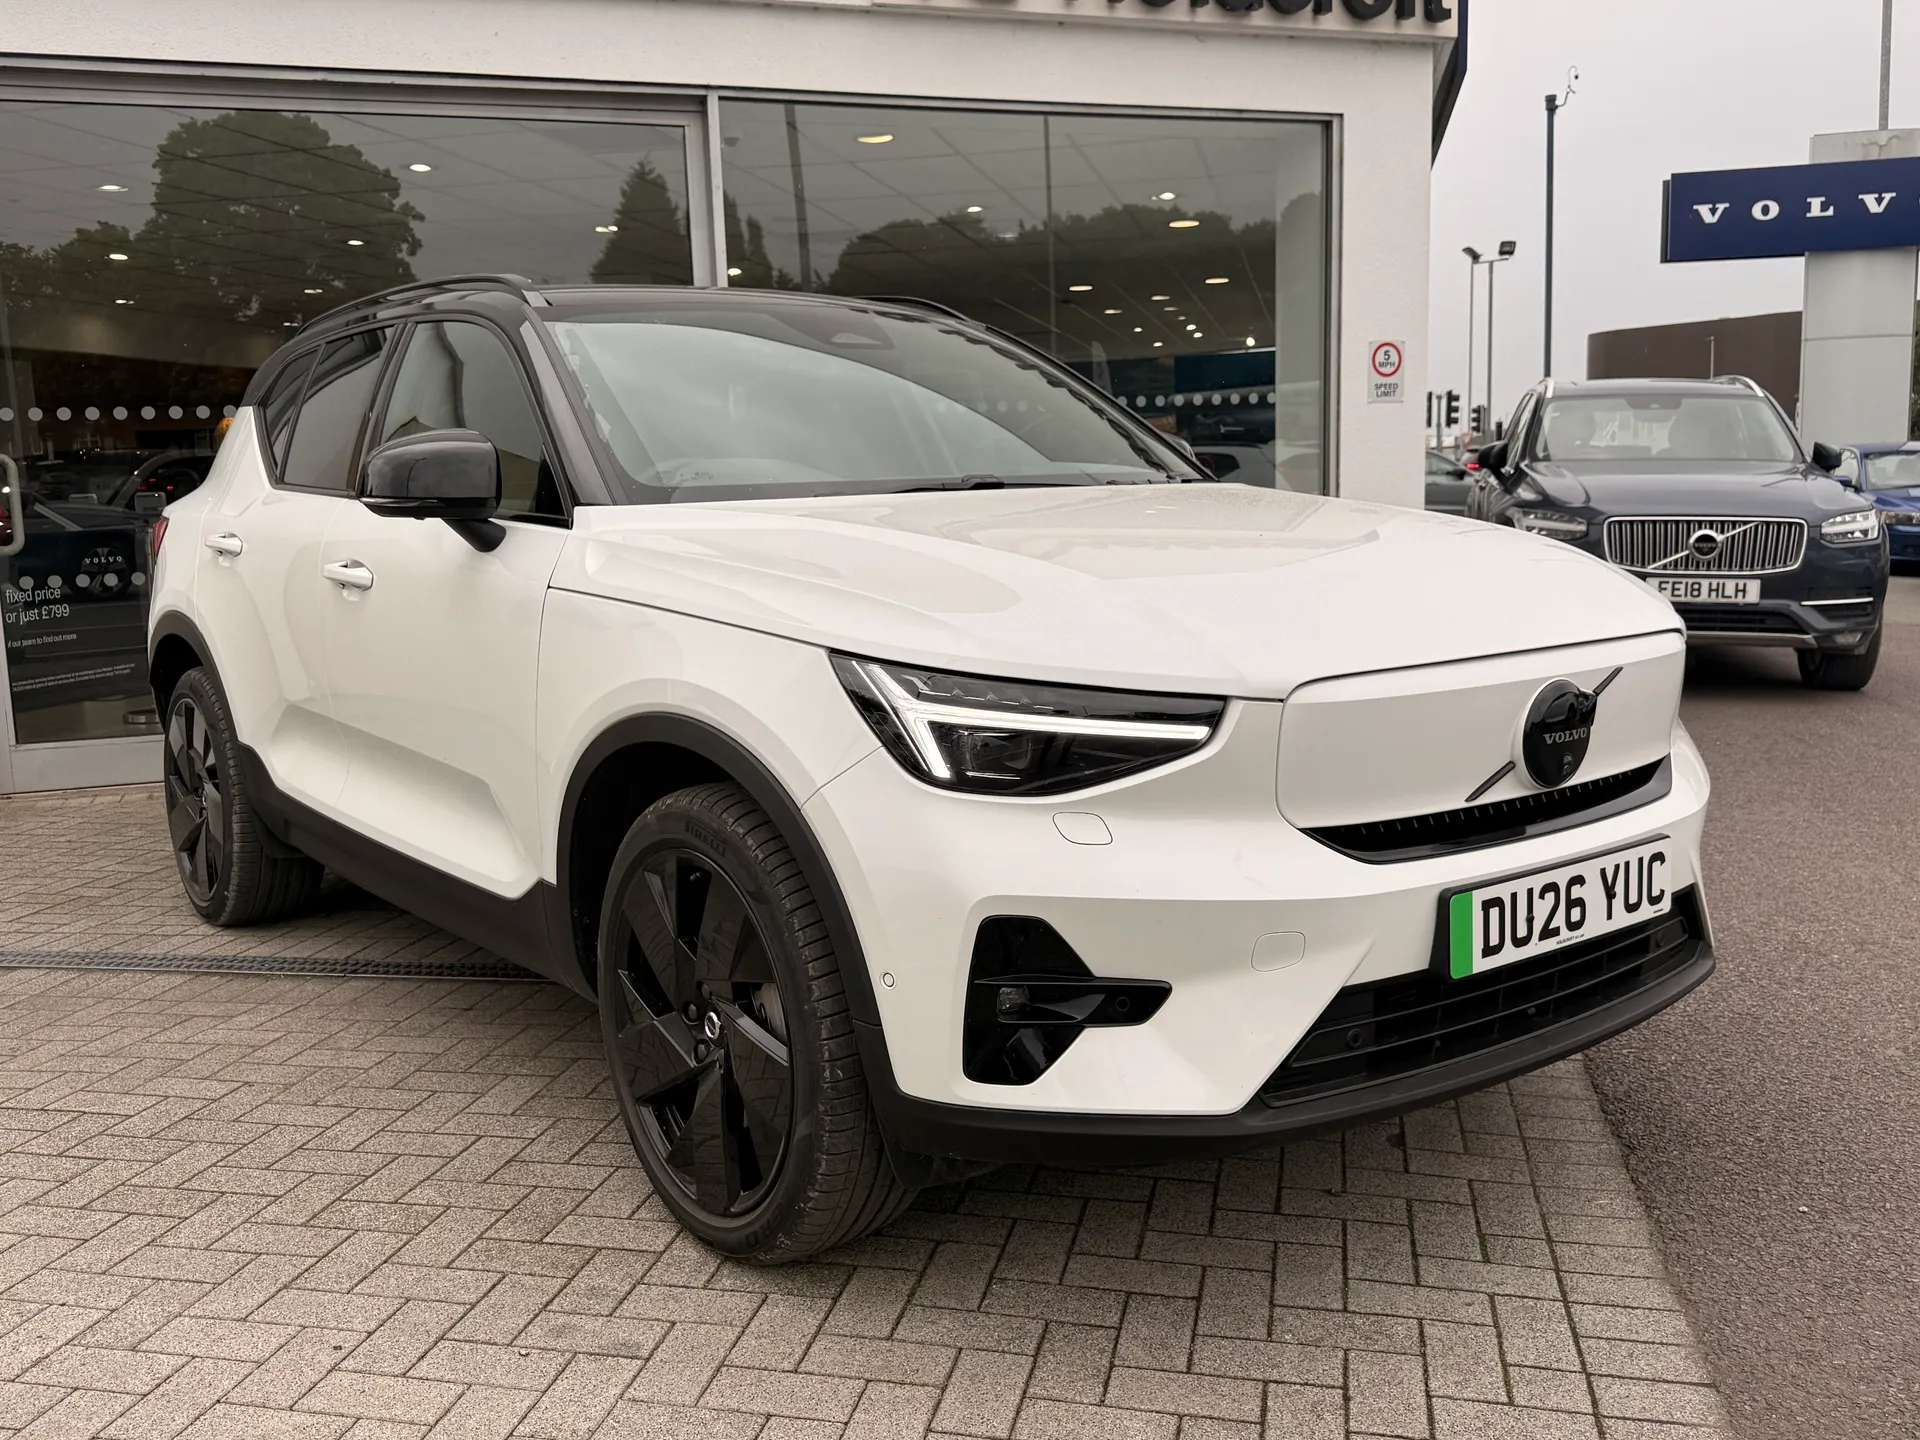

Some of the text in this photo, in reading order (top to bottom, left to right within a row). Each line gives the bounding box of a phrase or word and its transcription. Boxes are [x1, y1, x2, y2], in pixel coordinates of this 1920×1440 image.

[1693, 192, 1920, 224] VOLV
[1383, 350, 1391, 361] 5
[1374, 383, 1399, 391] SPEED
[84, 555, 123, 564] VOLVO
[6, 586, 61, 604] fixed price
[1658, 581, 1747, 599] FE18 HLH
[6, 604, 70, 625] or just £799
[1543, 727, 1588, 745] VOLVO
[1481, 851, 1667, 959] DU26 YUC
